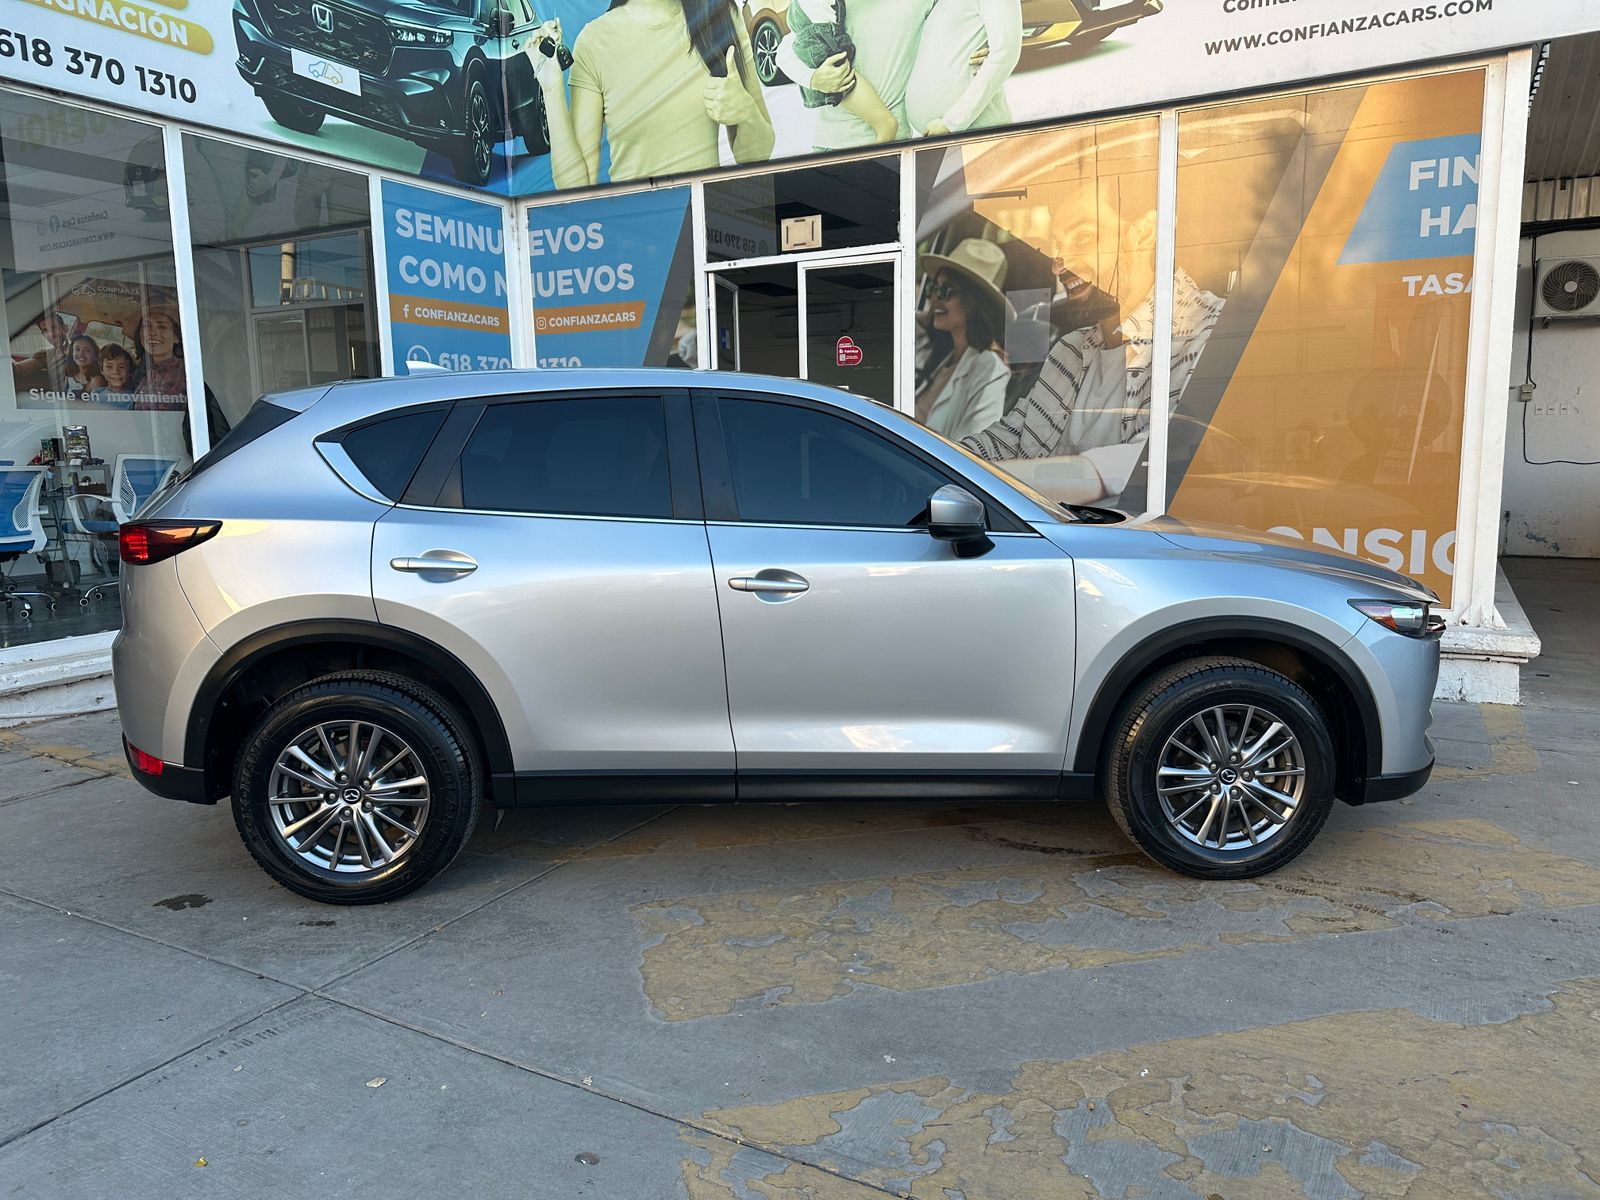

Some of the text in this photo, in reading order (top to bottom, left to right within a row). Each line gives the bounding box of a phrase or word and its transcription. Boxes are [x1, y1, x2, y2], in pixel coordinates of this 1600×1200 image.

[1205, 0, 1493, 55] WWW.CONFIANZACARS.COM
[0, 28, 197, 104] 618 370 1310
[399, 255, 486, 294] COMO
[415, 307, 500, 326] CONFIANZACARS
[549, 311, 636, 328] CONFIANZACARS
[29, 388, 76, 403] Sigue
[81, 391, 99, 402] en
